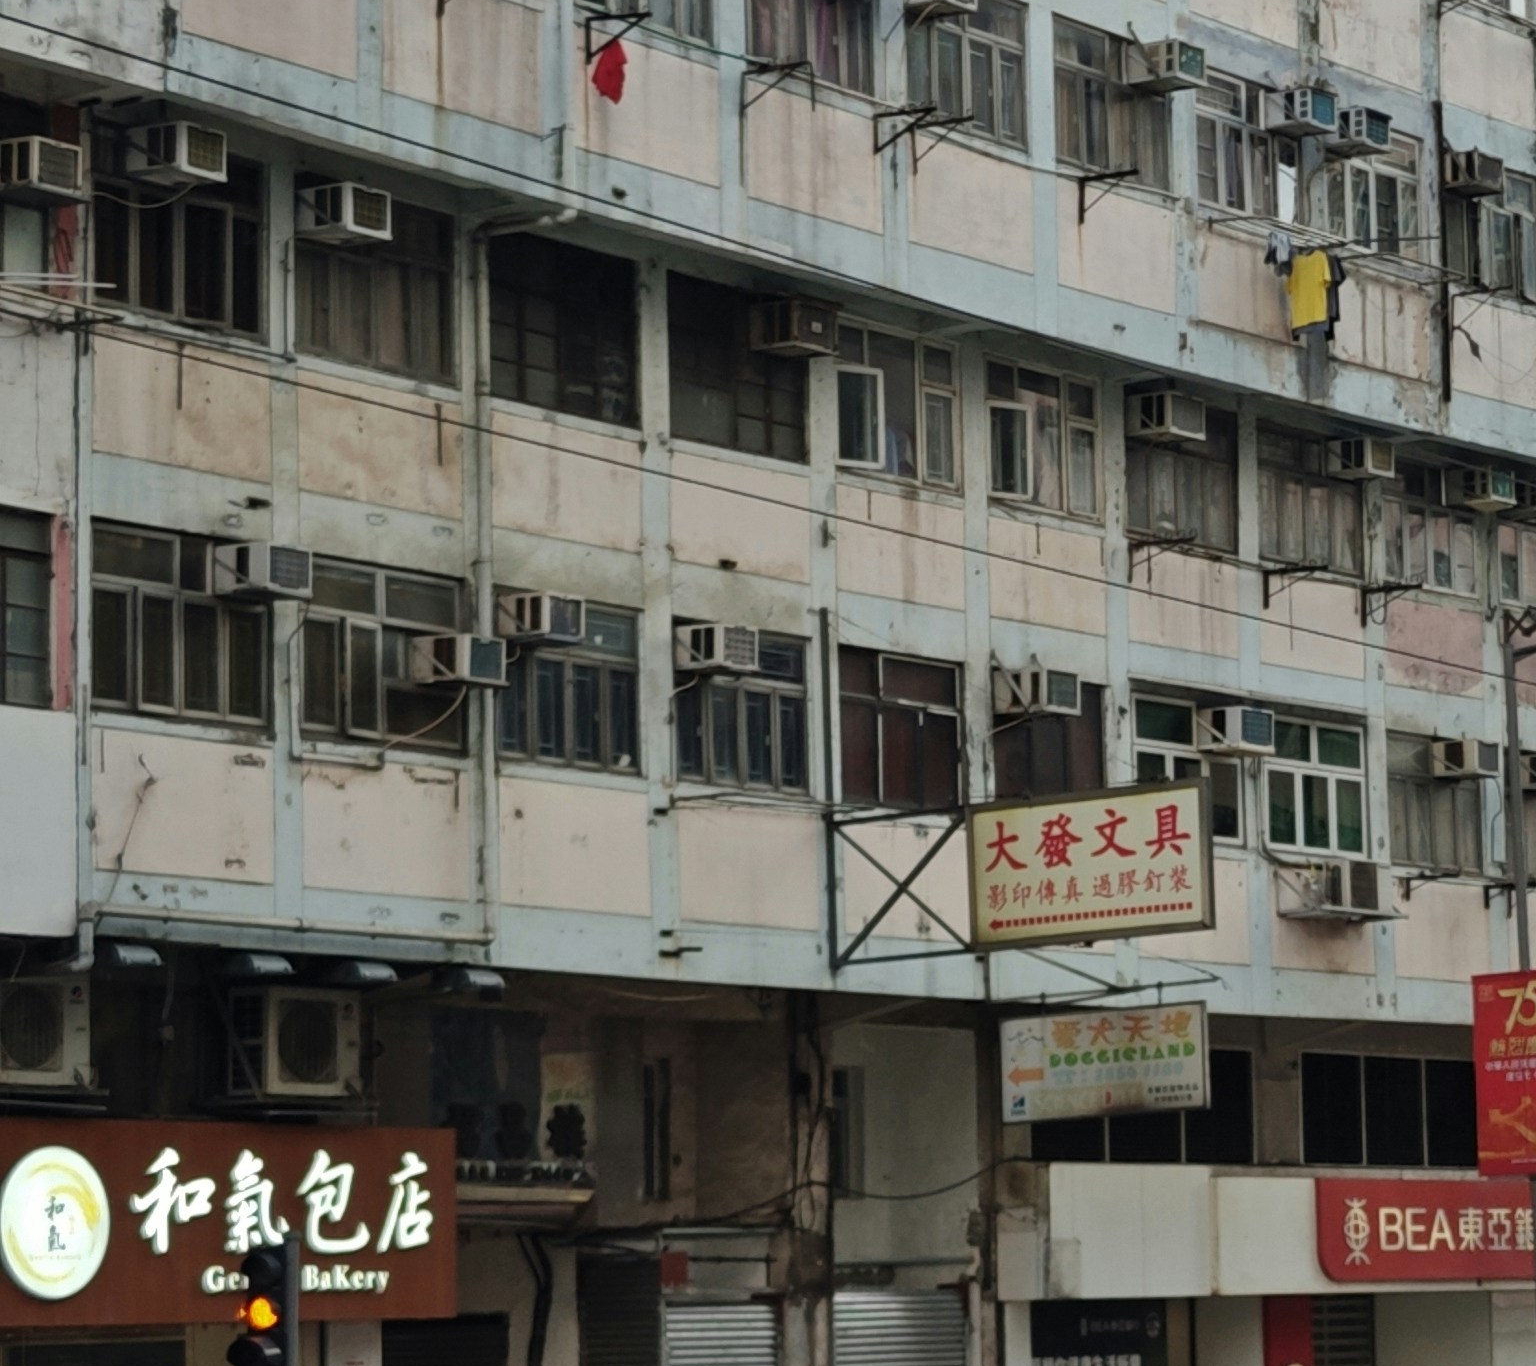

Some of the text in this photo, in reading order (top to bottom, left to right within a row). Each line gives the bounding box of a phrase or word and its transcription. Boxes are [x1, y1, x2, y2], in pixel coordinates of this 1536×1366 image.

[985, 804, 1191, 873] 大發文具
[987, 866, 1192, 912] 影印傳真 過膠釘裝
[1052, 1011, 1191, 1050] 愛犬天地
[45, 1196, 66, 1252] 和氣
[131, 1147, 434, 1255] 和氣包店
